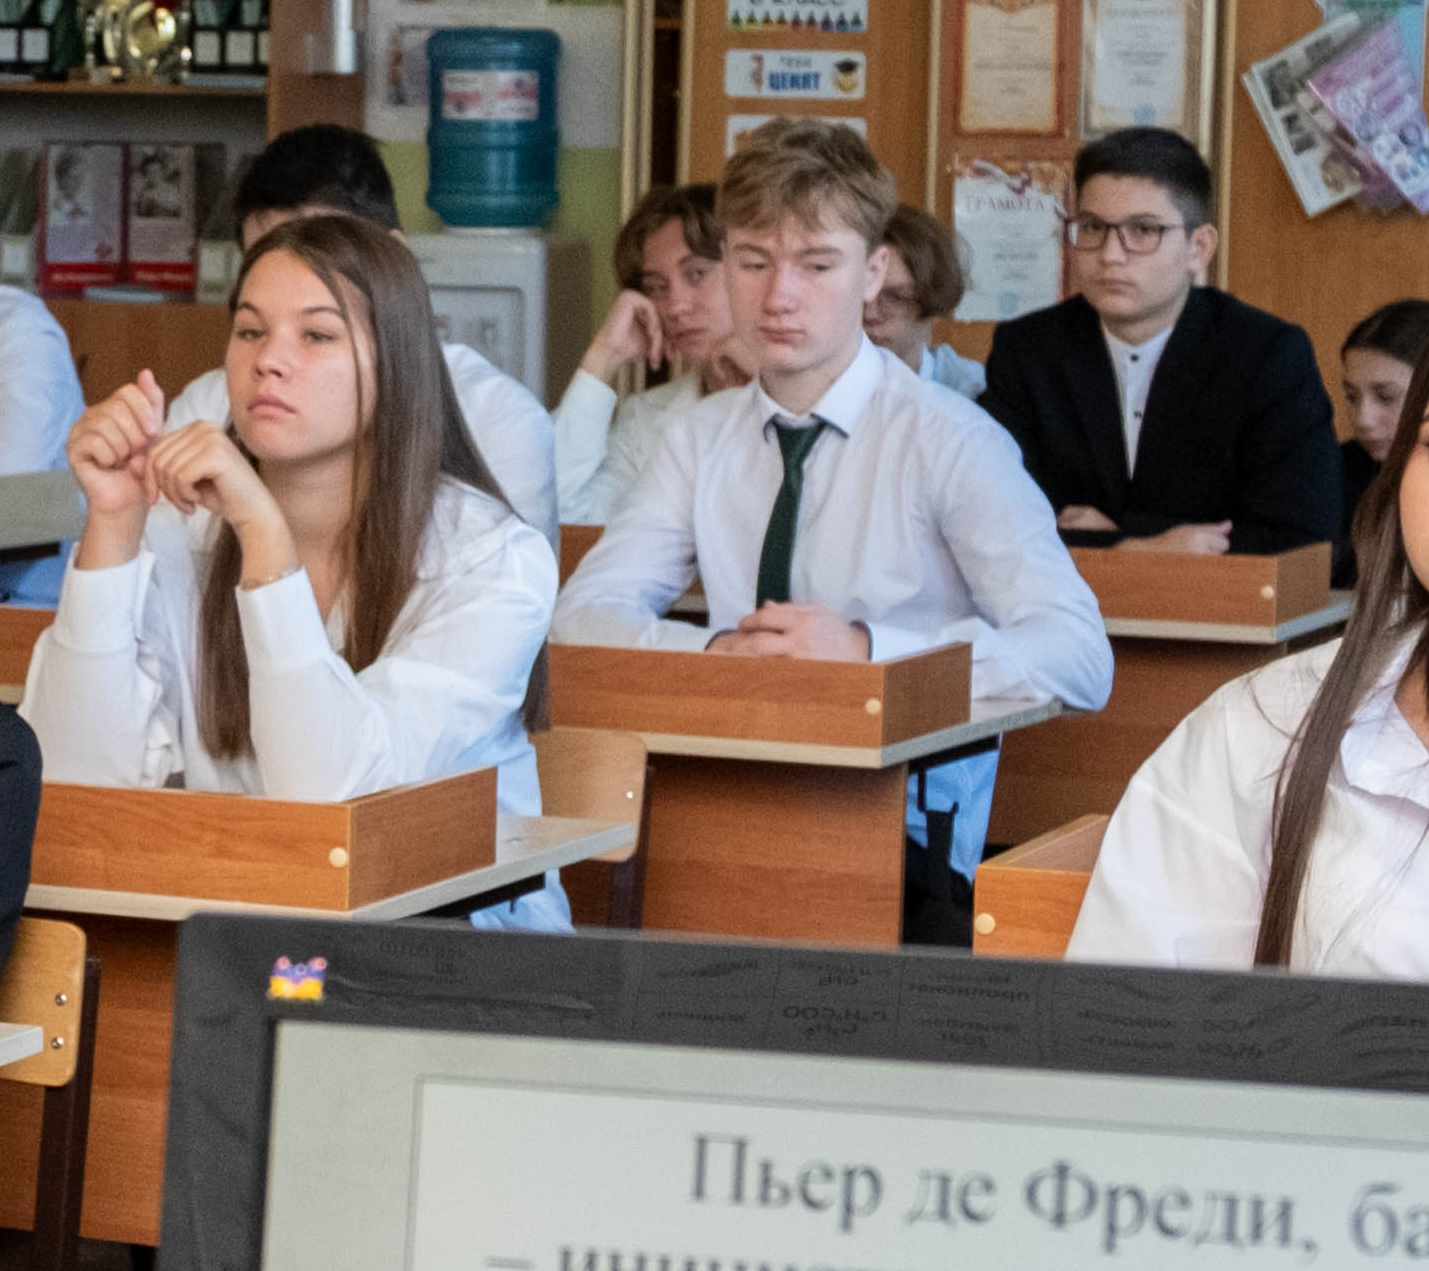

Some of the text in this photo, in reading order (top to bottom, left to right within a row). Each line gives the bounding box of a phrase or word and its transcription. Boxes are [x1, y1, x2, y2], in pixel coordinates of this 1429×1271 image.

[689, 1130, 884, 1230] Пьер
[906, 1166, 996, 1227] де
[1022, 1158, 1319, 1258] Фреди,
